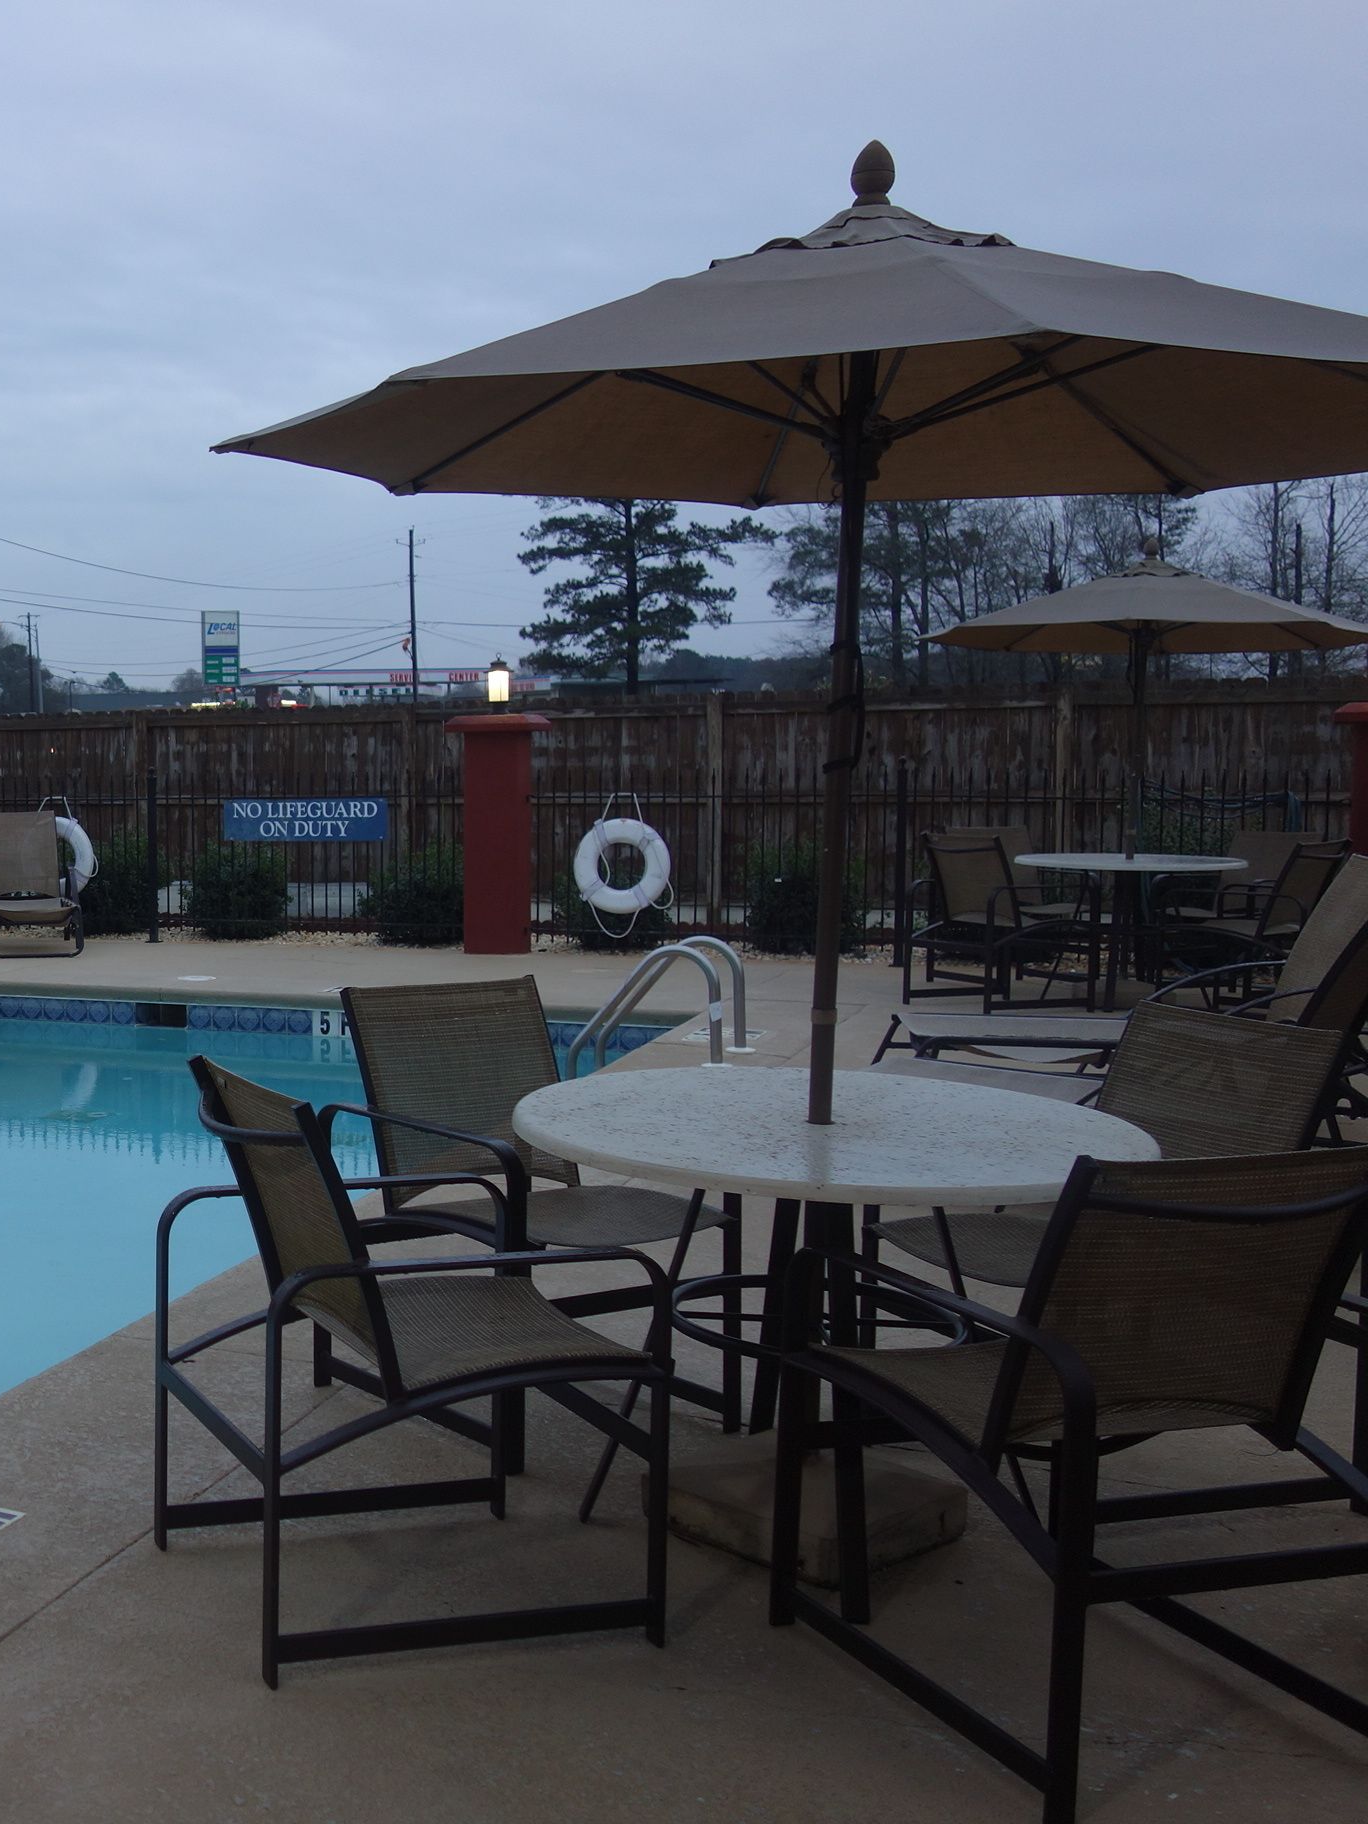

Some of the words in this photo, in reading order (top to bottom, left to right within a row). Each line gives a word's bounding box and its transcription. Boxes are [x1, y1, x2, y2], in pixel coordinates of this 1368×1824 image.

[448, 671, 479, 681] CENTER
[233, 802, 262, 819] NO
[267, 801, 378, 818] LIFEGUARD
[260, 820, 289, 837] ON
[293, 820, 350, 837] DUTY
[320, 1011, 330, 1035] 5
[341, 1012, 350, 1036] F
